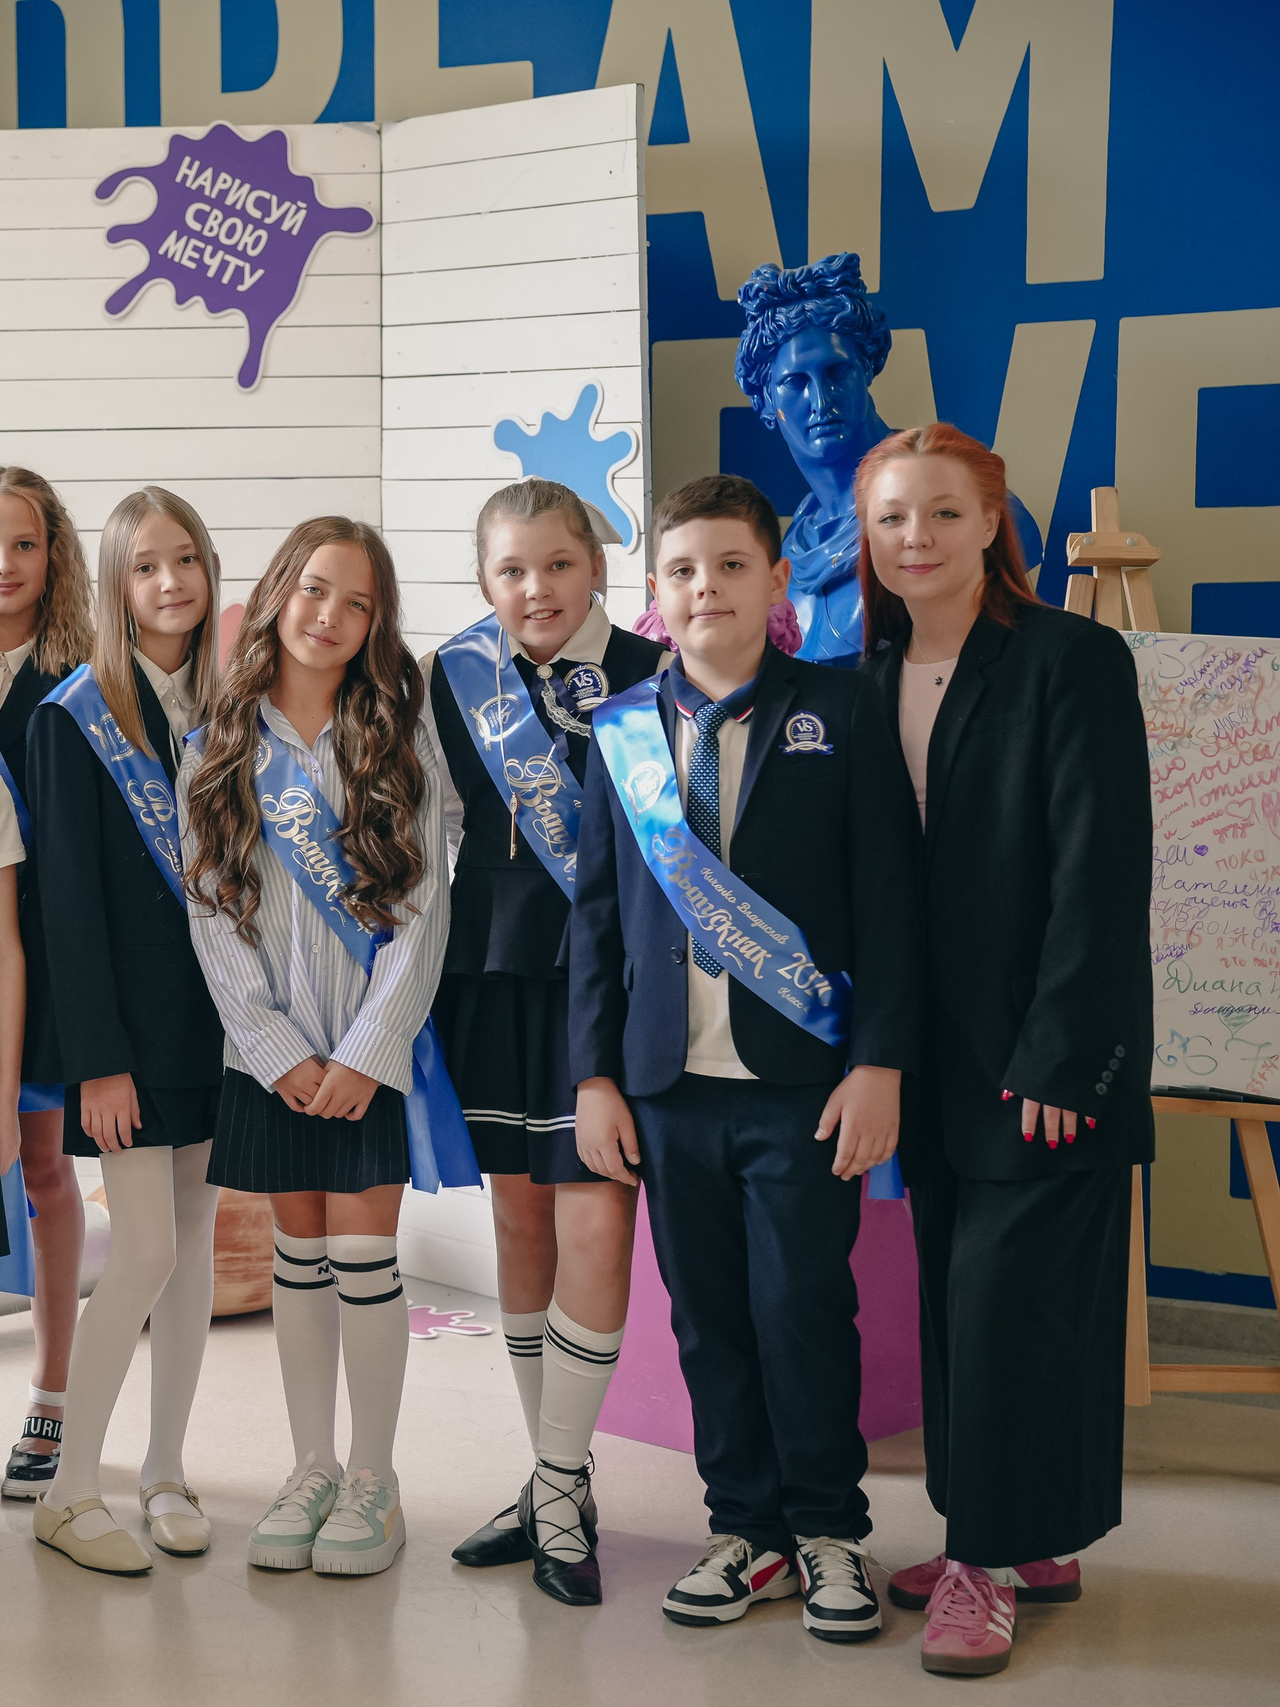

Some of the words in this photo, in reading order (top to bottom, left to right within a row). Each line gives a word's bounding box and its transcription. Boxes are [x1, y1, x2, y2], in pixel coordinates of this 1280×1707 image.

[175, 156, 308, 236] НАРИСУЙ
[158, 230, 264, 292] МЕЧТУ
[185, 203, 268, 258] СВОЮ
[652, 826, 773, 979] Выпускник
[737, 902, 789, 945] Владислав
